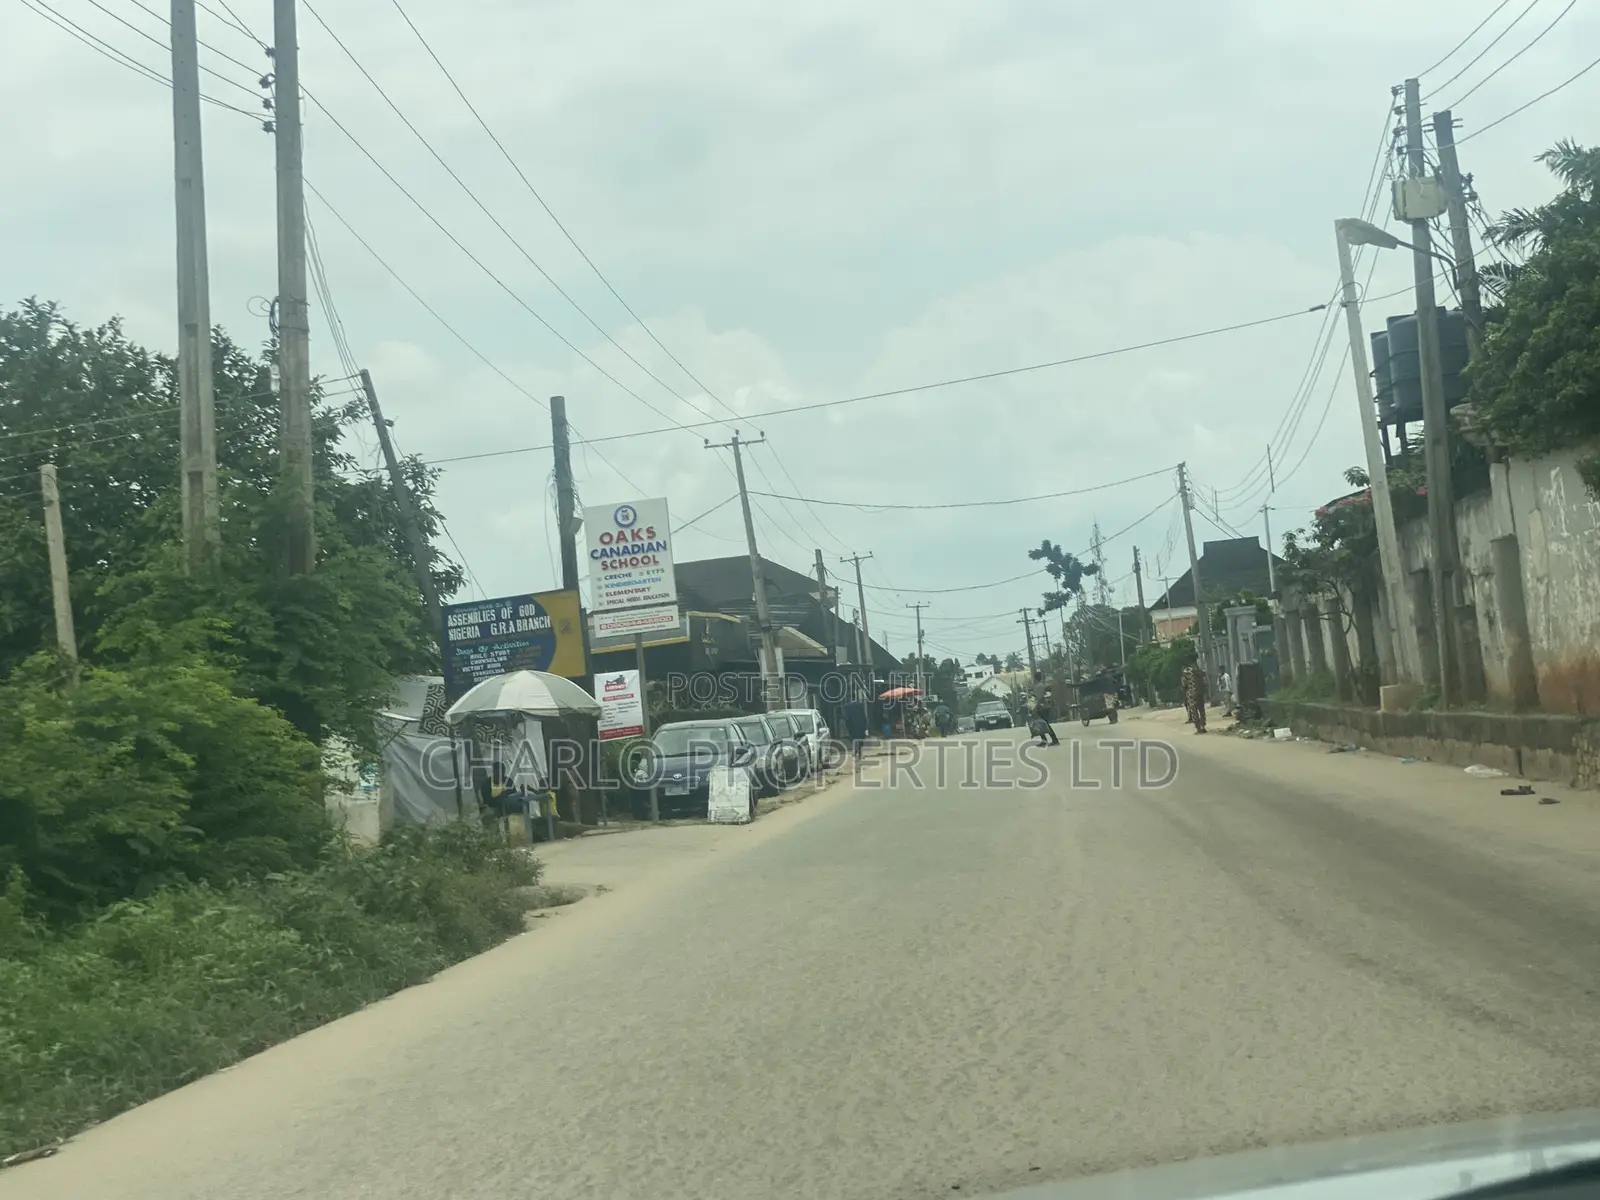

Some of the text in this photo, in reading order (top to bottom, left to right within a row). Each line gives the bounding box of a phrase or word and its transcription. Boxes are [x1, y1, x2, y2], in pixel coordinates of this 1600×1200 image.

[599, 526, 656, 545] OAKS
[590, 540, 667, 560] CANADIAN
[601, 554, 660, 570] SCHOOL
[604, 572, 632, 580] CRECHE
[604, 577, 662, 588] KINDERGARTEN
[605, 586, 651, 597] ELEMENTARY
[643, 592, 670, 600] EDUCATION
[448, 608, 496, 627] ASSEMBLIES
[501, 606, 513, 620] OF
[519, 603, 536, 618] GOD
[448, 626, 480, 641] NIGERIA
[516, 615, 552, 632] BRANCH
[490, 650, 510, 658] STUDY
